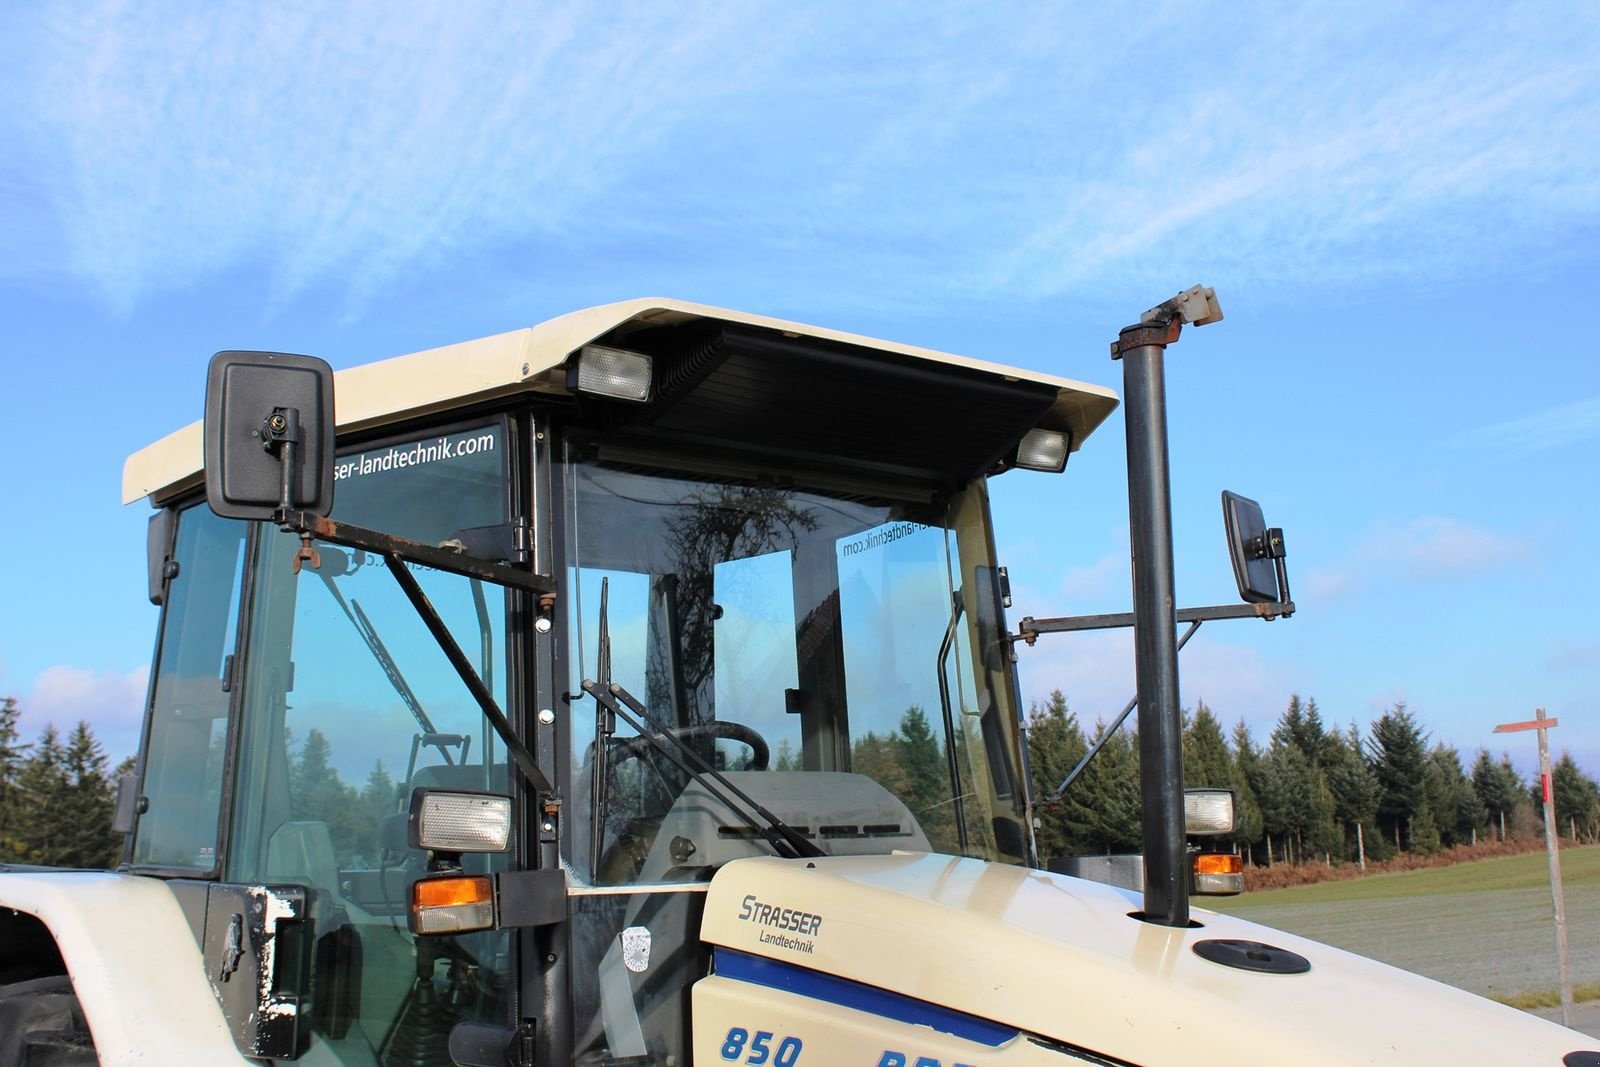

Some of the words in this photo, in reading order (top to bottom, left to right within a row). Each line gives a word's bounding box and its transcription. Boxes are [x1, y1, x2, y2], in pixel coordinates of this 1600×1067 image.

[738, 894, 822, 937] STRASSER
[759, 929, 815, 954] Landtechnik
[720, 1027, 803, 1067] 850
